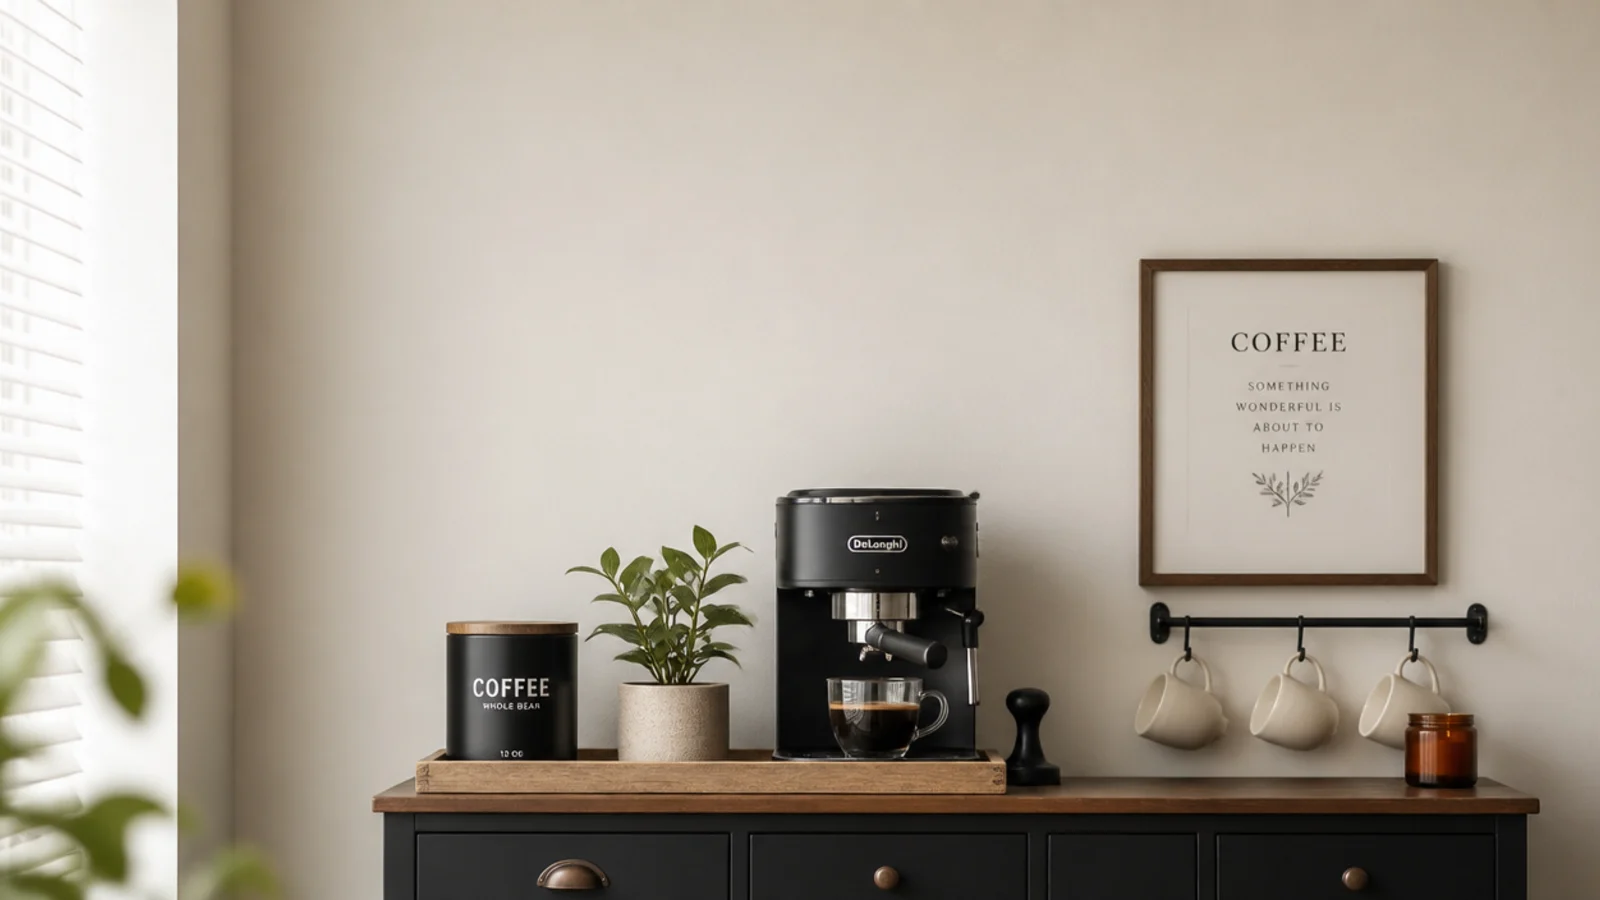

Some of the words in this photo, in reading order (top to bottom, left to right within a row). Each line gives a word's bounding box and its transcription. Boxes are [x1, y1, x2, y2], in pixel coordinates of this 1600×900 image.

[1231, 331, 1347, 353] COFFEE
[1248, 381, 1330, 392] SOMETHING
[1236, 402, 1323, 412] WONDERFUL
[1329, 402, 1342, 412] IS
[1253, 422, 1300, 433] ABOUT
[1306, 422, 1324, 433] TO
[1261, 443, 1316, 454] HAPPEN
[473, 678, 550, 698] COFFEE
[483, 702, 514, 710] WHOLE
